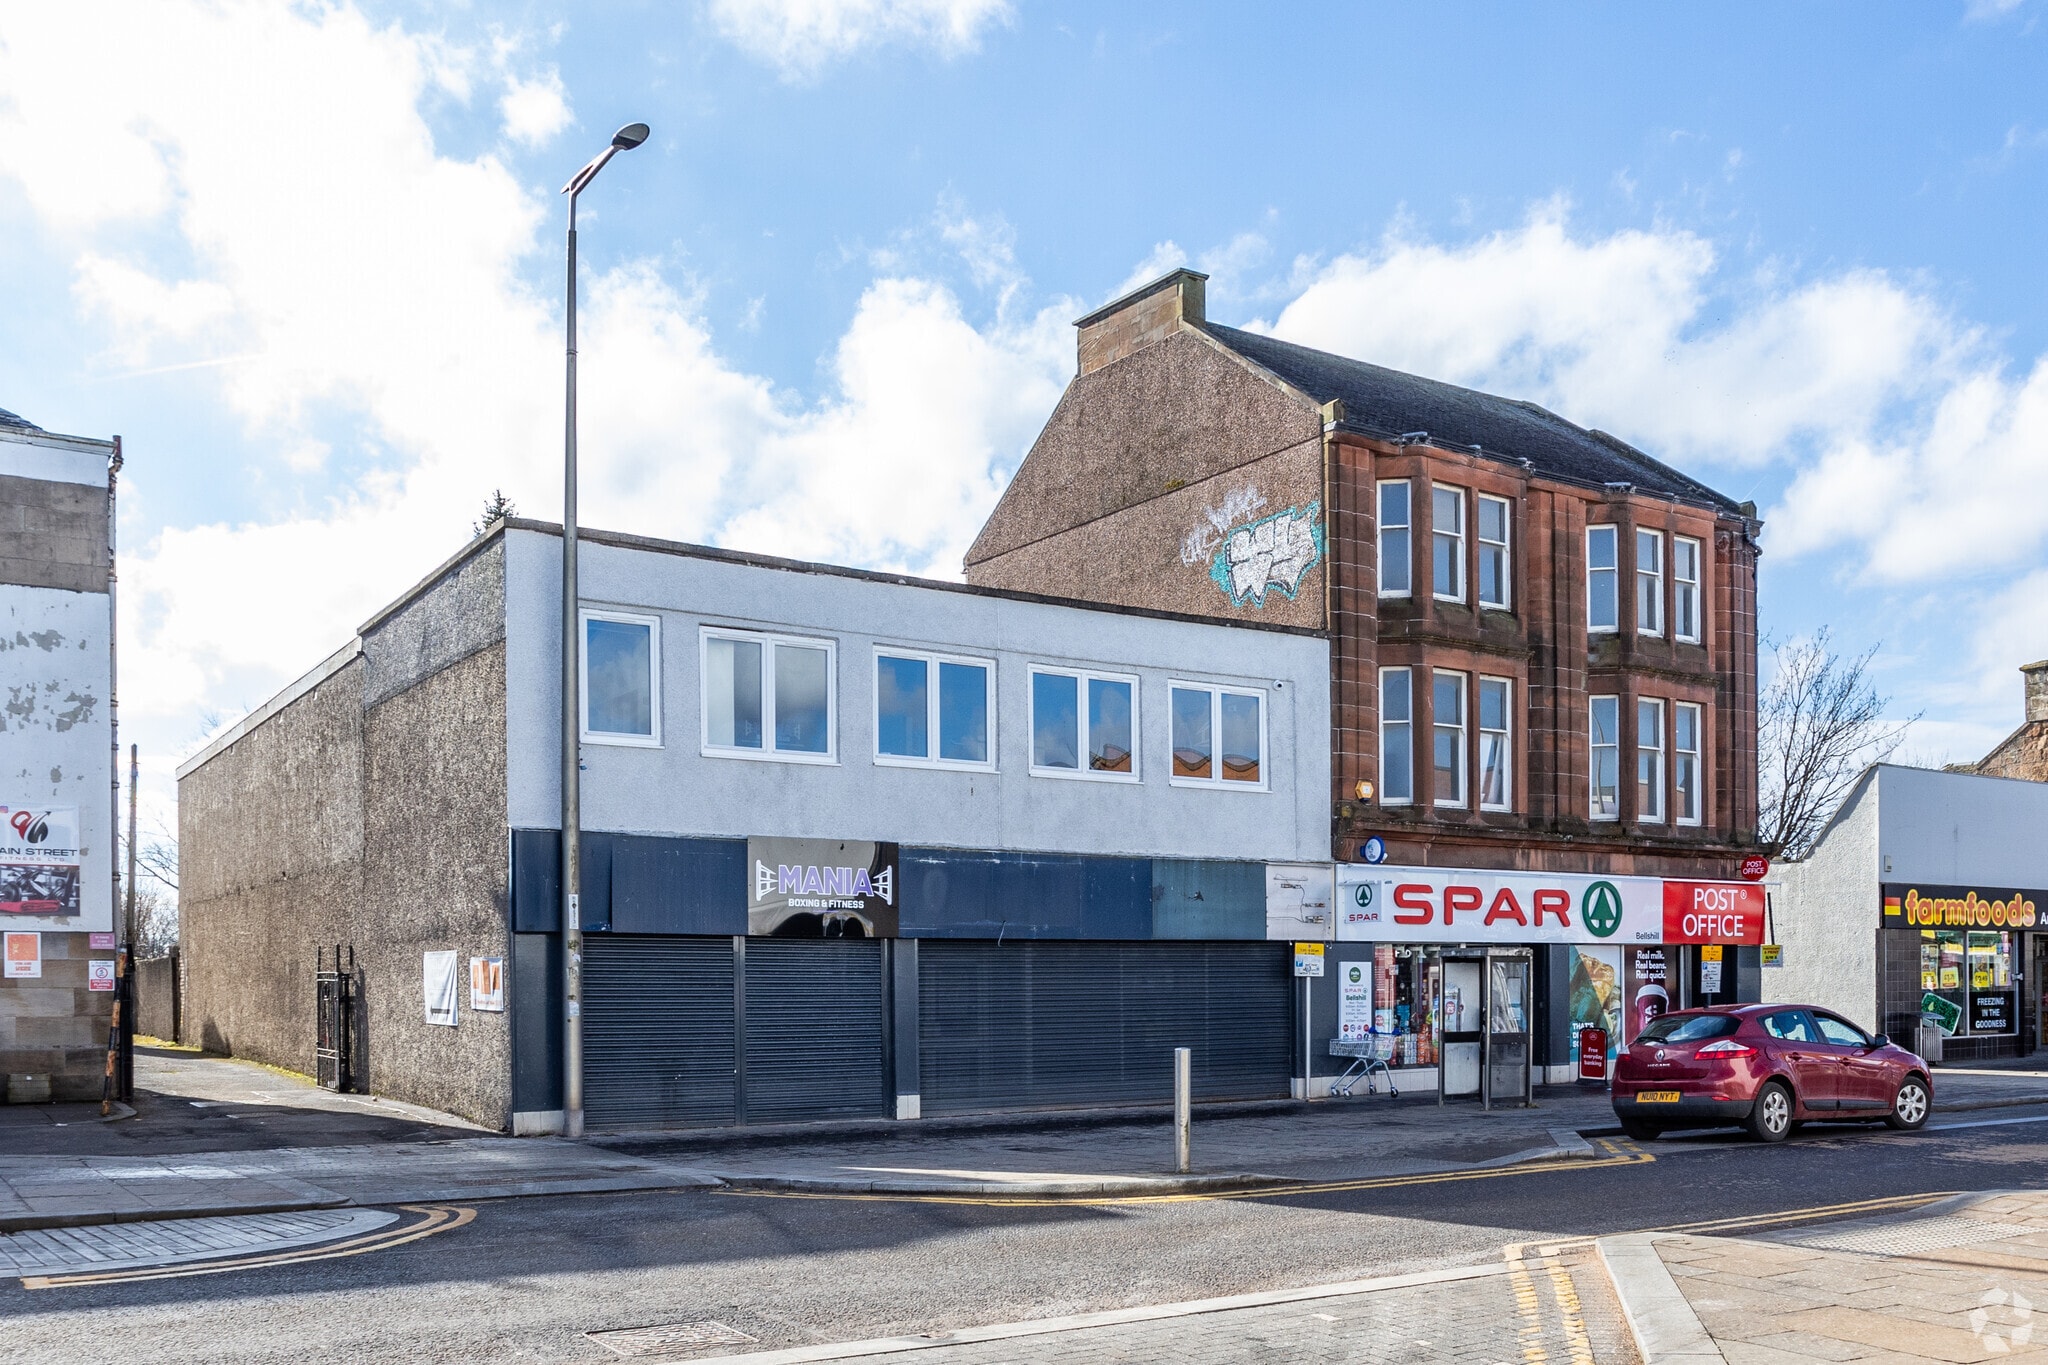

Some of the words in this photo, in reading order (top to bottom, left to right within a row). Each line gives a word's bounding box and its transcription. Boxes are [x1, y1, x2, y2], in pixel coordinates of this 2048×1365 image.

[0, 847, 20, 855] AIN
[25, 847, 78, 857] STREET
[1743, 867, 1765, 875] OFFICE
[778, 864, 875, 897] MANIA
[788, 898, 820, 907] BOXING
[821, 899, 828, 908] &
[828, 899, 865, 909] FITNESS
[1694, 887, 1739, 911] POST
[1393, 883, 1571, 928] SPAR
[1905, 888, 2036, 928] farmfoods
[1349, 913, 1378, 922] SPAR
[1682, 913, 1744, 937] OFFICE
[1635, 932, 1660, 940] Bellshill
[1636, 950, 1650, 960] Real
[1650, 950, 1665, 960] milk.
[1635, 960, 1648, 969] Real
[1648, 960, 1667, 969] beans.
[1635, 970, 1649, 979] Real
[1649, 970, 1667, 982] quick.
[1977, 997, 2005, 1006] FREEZING
[1981, 1009, 1988, 1017] IN
[1989, 1008, 2000, 1017] THE
[1572, 1022, 1594, 1030] THAT'S
[1975, 1019, 2006, 1029] GOODNESS
[1659, 1092, 1676, 1101] NYT
